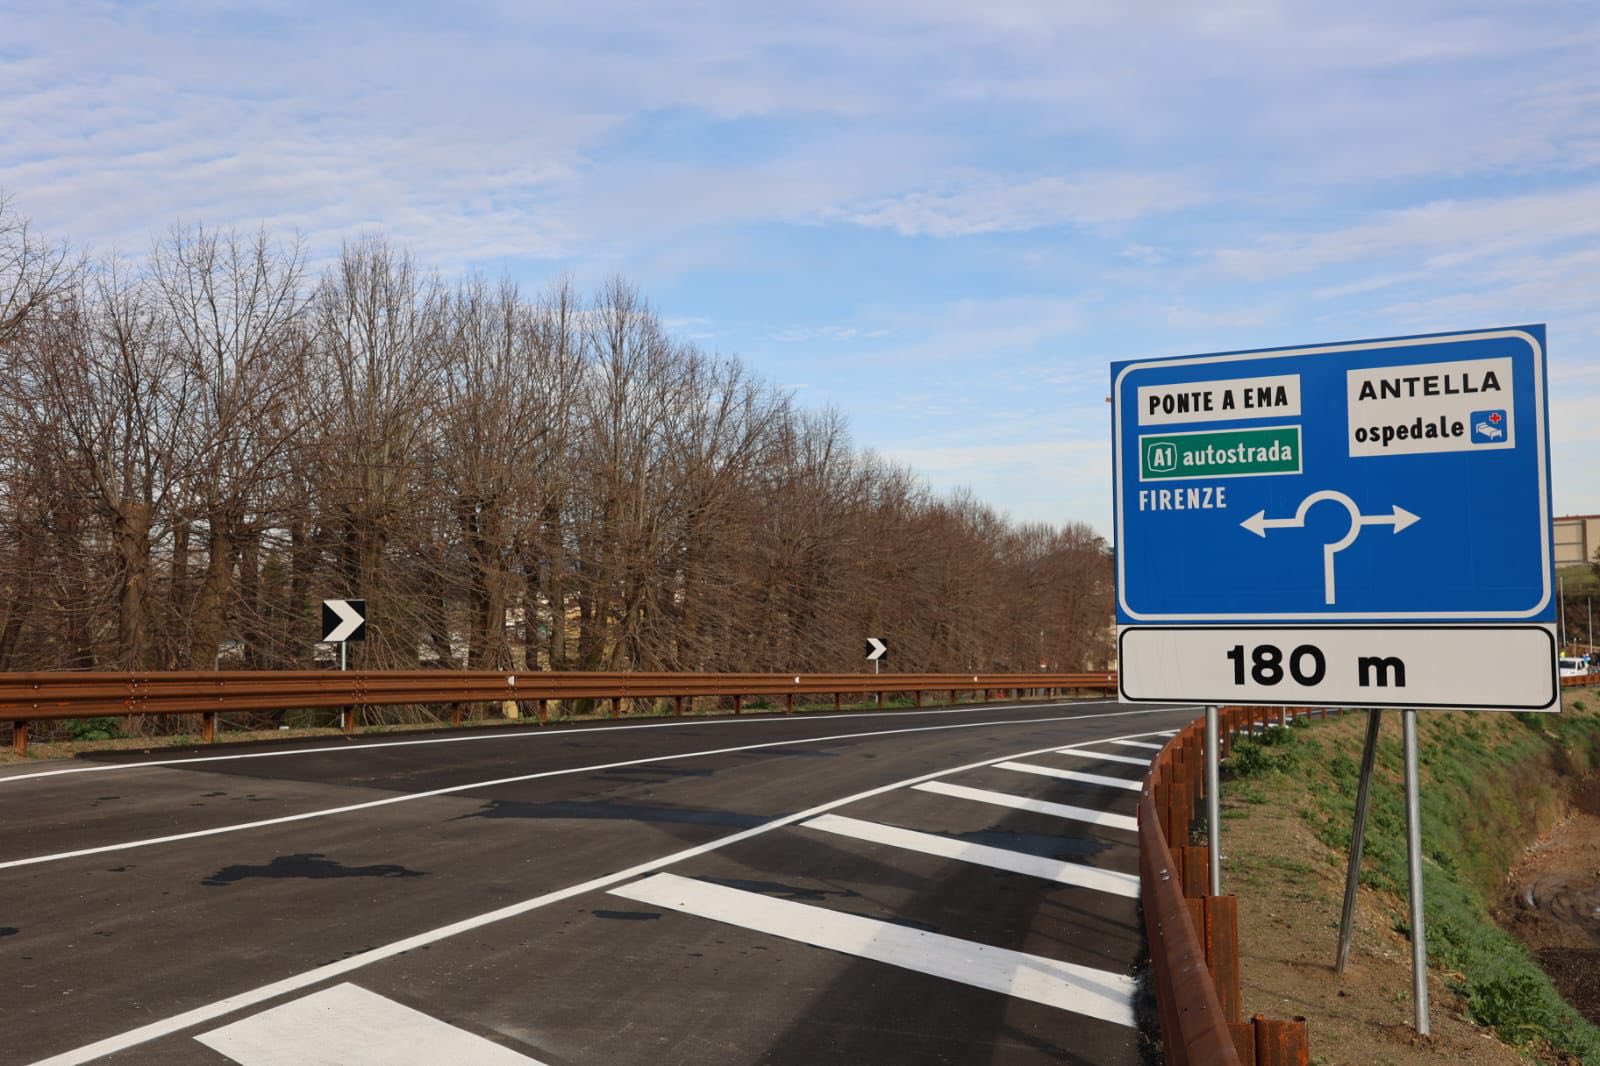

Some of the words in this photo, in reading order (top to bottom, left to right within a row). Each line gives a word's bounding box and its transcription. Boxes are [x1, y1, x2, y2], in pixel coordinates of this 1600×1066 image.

[1149, 391, 1214, 415] PONTE
[1222, 389, 1235, 410] A
[1243, 385, 1288, 409] EMA
[1358, 371, 1501, 401] ANTELLA
[1355, 415, 1464, 447] ospedale
[1153, 447, 1172, 467] A1
[1182, 439, 1293, 466] autostrada
[1139, 486, 1227, 511] FIRENZE
[1226, 644, 1326, 686] 180
[1357, 656, 1406, 687] m
